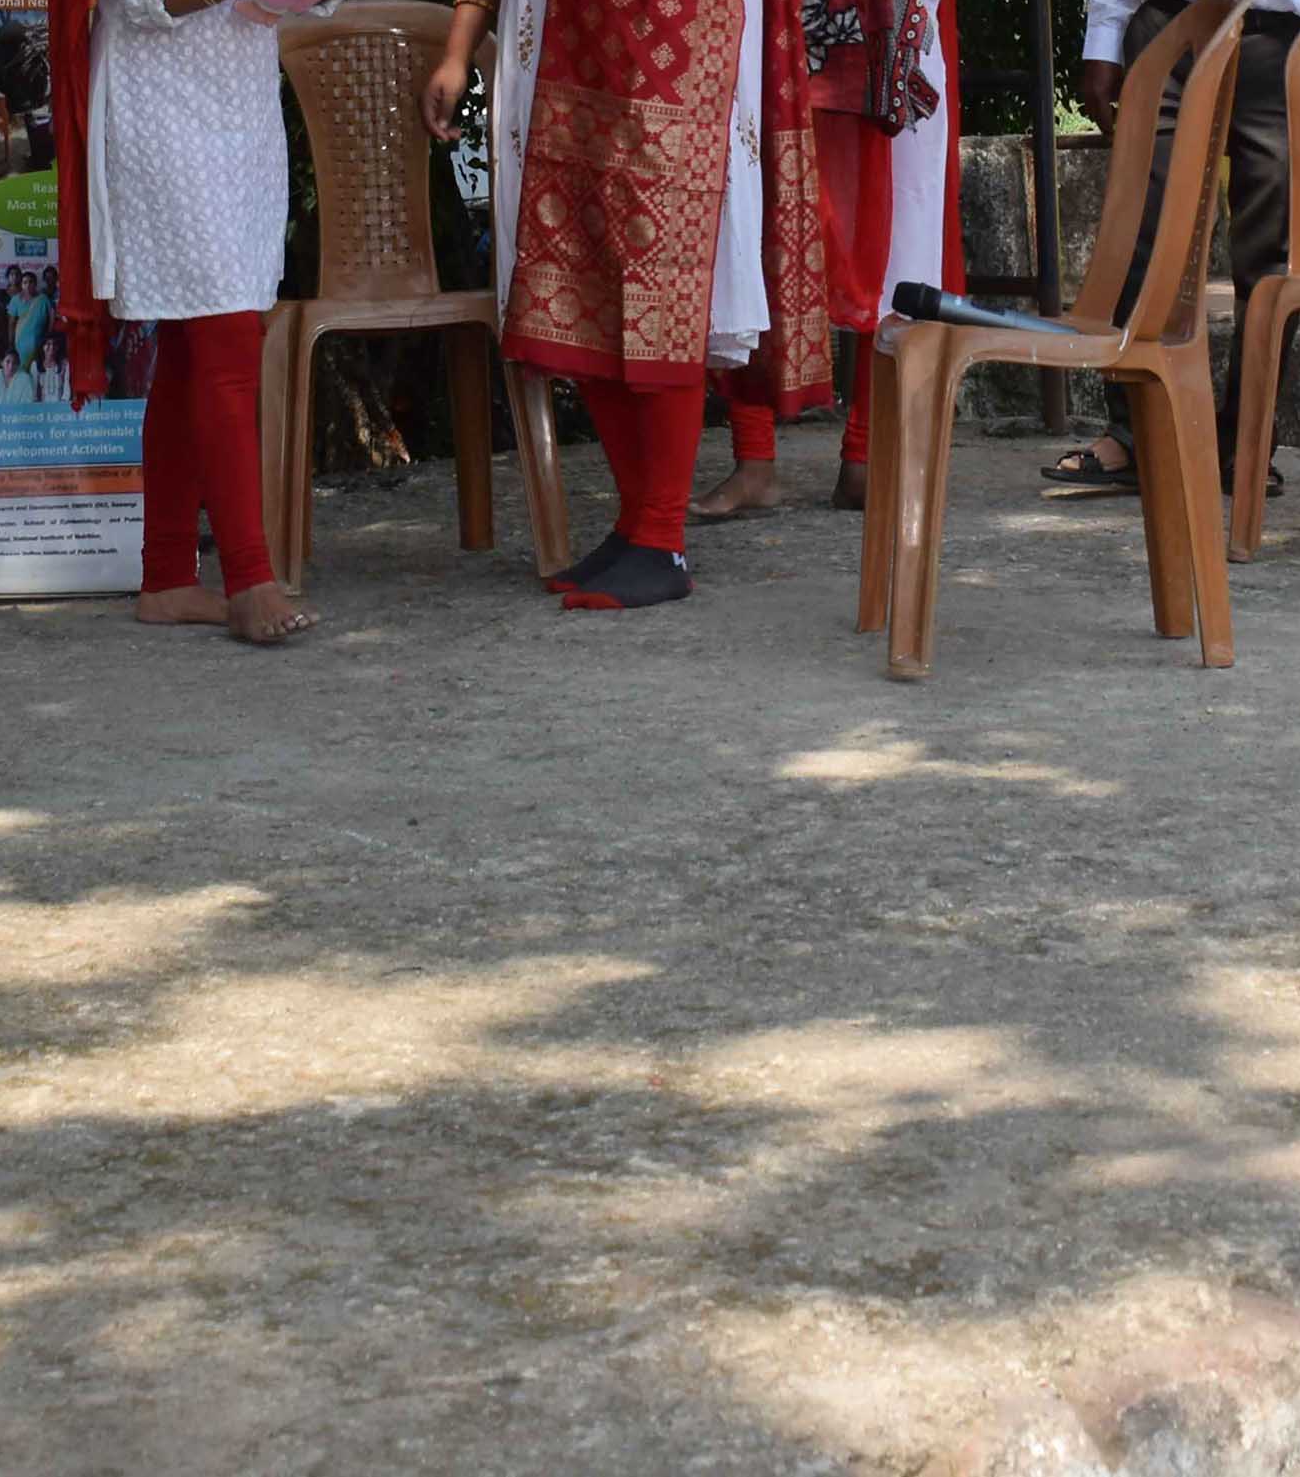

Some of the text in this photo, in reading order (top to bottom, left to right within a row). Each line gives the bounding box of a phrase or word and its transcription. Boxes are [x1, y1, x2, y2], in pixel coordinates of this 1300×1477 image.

[7, 199, 36, 211] Most
[1, 411, 43, 424] trained
[46, 410, 75, 423] Local
[78, 410, 121, 421] Female
[50, 428, 65, 439] for
[69, 426, 135, 438] sustainable
[71, 443, 125, 456] Activities
